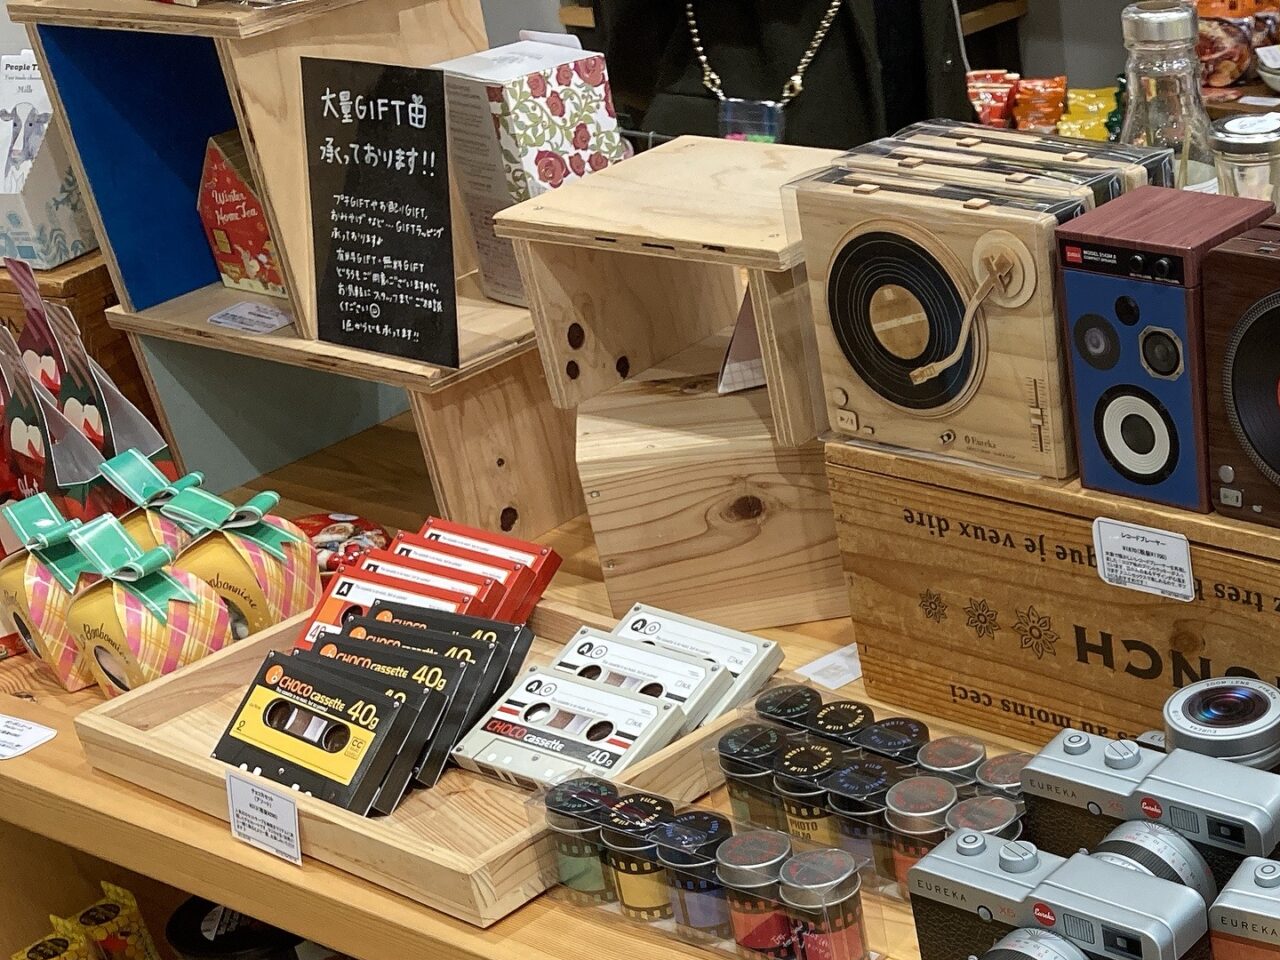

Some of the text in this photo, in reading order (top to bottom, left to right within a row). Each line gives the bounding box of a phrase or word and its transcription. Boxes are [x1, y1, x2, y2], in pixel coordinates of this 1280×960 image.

[5, 63, 31, 71] People
[212, 190, 246, 204] Winter
[215, 202, 258, 226] Home Tea
[903, 508, 950, 538] dire
[958, 521, 1016, 550] veux
[1120, 531, 1167, 546] レコードプレーヤー
[1024, 534, 1046, 563] je
[1214, 582, 1264, 613] tres
[336, 651, 447, 692] CHOCO cassette 40g
[278, 675, 380, 731] CHOCO cassette 40g
[949, 683, 993, 707] ceci
[1000, 696, 1073, 729] moins
[351, 738, 364, 750] CC
[485, 719, 613, 768] CHOCO cassette 40g
[1029, 778, 1078, 799] EUREKA
[1141, 802, 1163, 815] Eureka
[789, 820, 819, 832] PHOTO
[916, 879, 968, 903] EUREKA
[1033, 907, 1056, 921] Eureka
[1220, 915, 1279, 938] EUREKA
